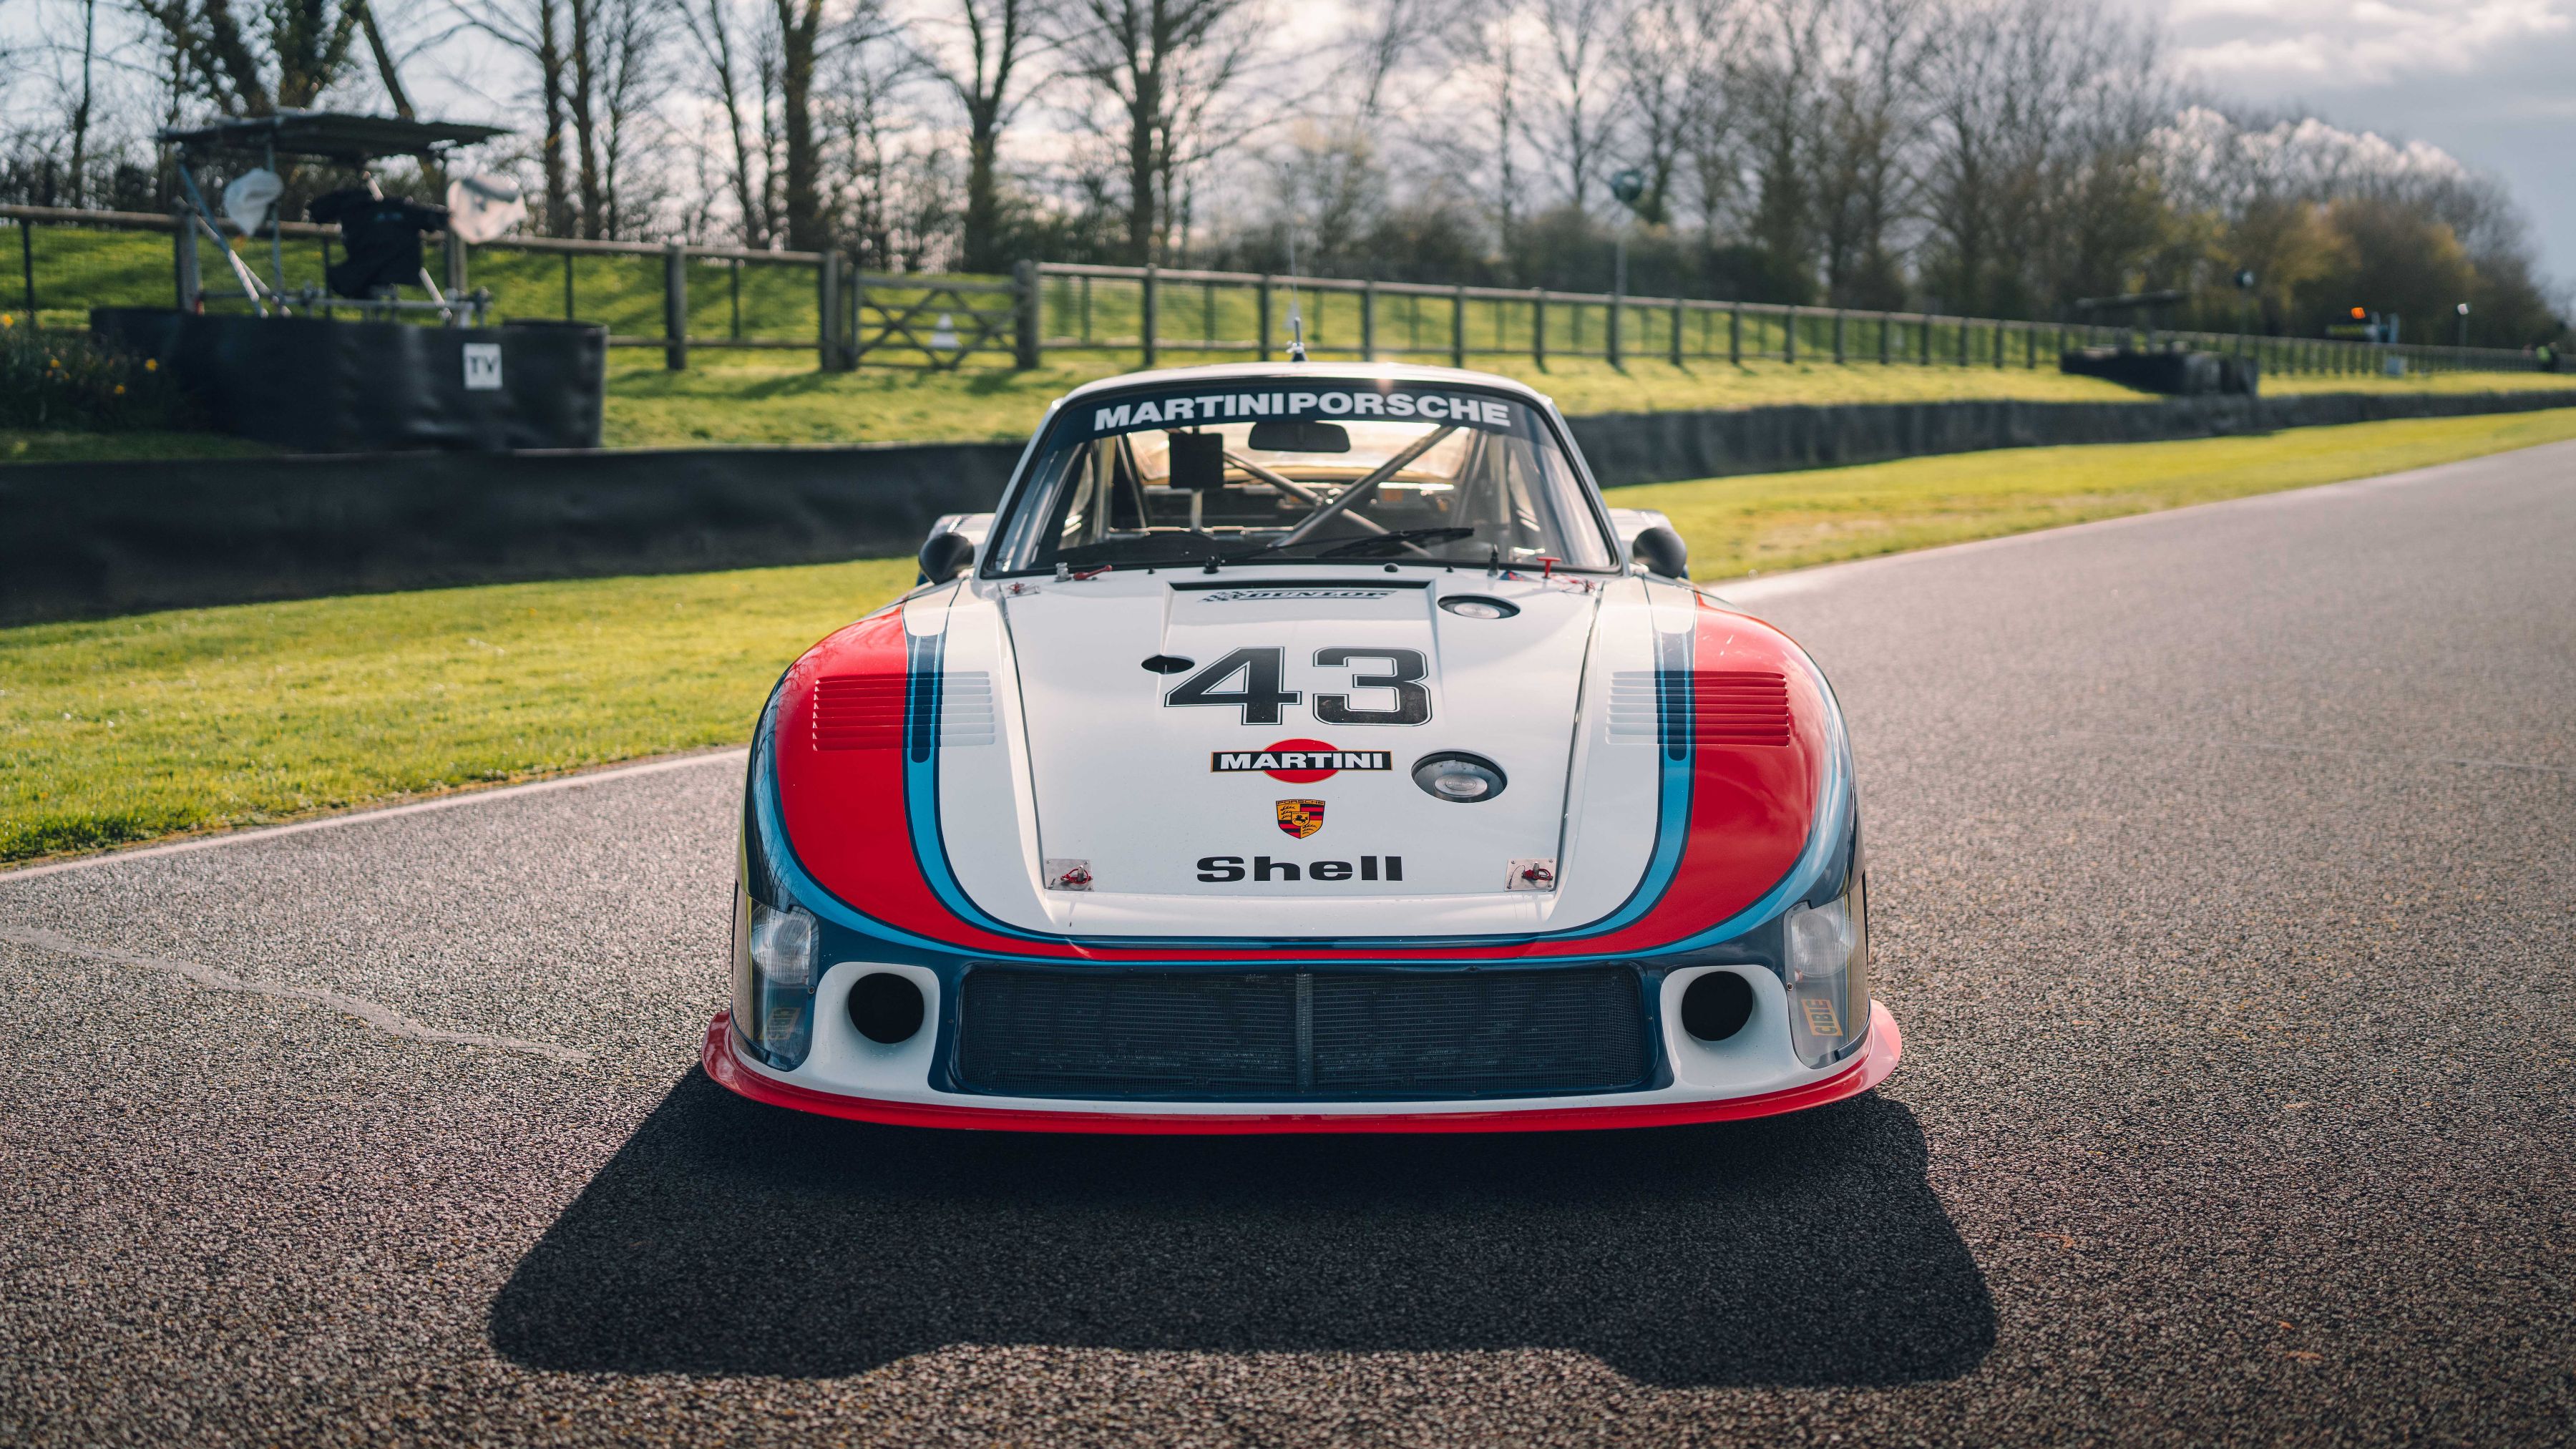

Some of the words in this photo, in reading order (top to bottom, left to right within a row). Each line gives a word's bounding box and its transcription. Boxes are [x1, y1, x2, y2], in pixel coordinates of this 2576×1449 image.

[469, 355, 497, 374] TV
[1164, 646, 1433, 726] 43
[1220, 753, 1383, 769] MARTINI
[1196, 855, 1403, 883] Shell
